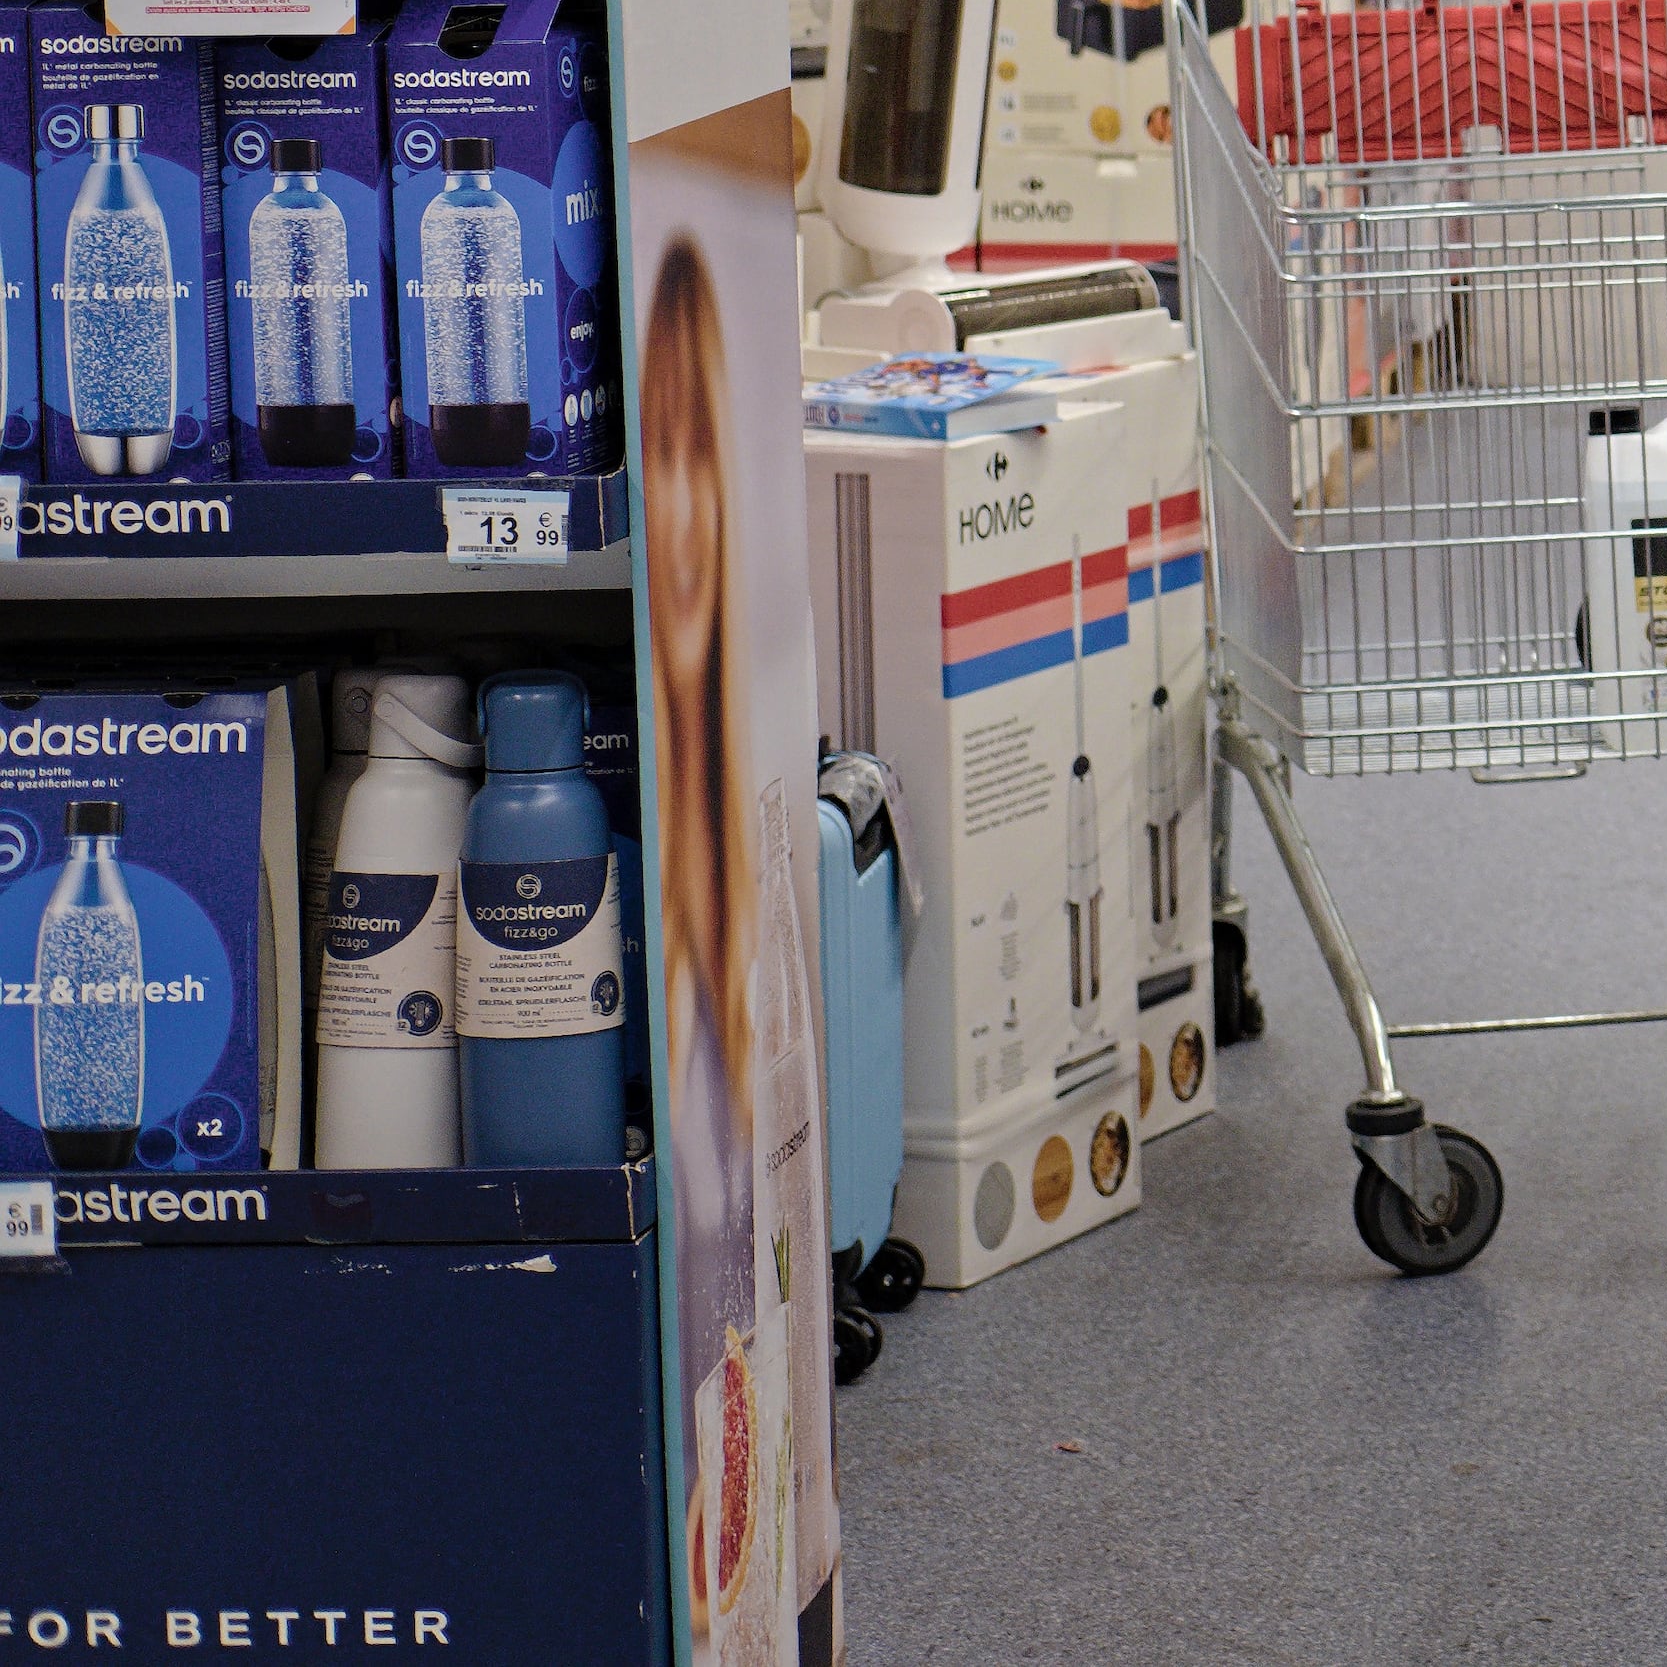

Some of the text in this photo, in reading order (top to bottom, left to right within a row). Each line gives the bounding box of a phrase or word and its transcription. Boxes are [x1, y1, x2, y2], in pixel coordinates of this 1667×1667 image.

[40, 35, 182, 55] sodastream
[224, 70, 357, 90] sodastream
[394, 67, 531, 90] sodastream
[51, 279, 190, 303] fizz & refresh
[235, 278, 369, 302] fizz refresh
[405, 278, 545, 302] fizz refresh
[475, 902, 587, 922] sodastream
[504, 925, 558, 941] fizz&go
[81, 974, 205, 1003] refresh
[196, 1118, 223, 1137] x2
[166, 1609, 450, 1647] BETTER
